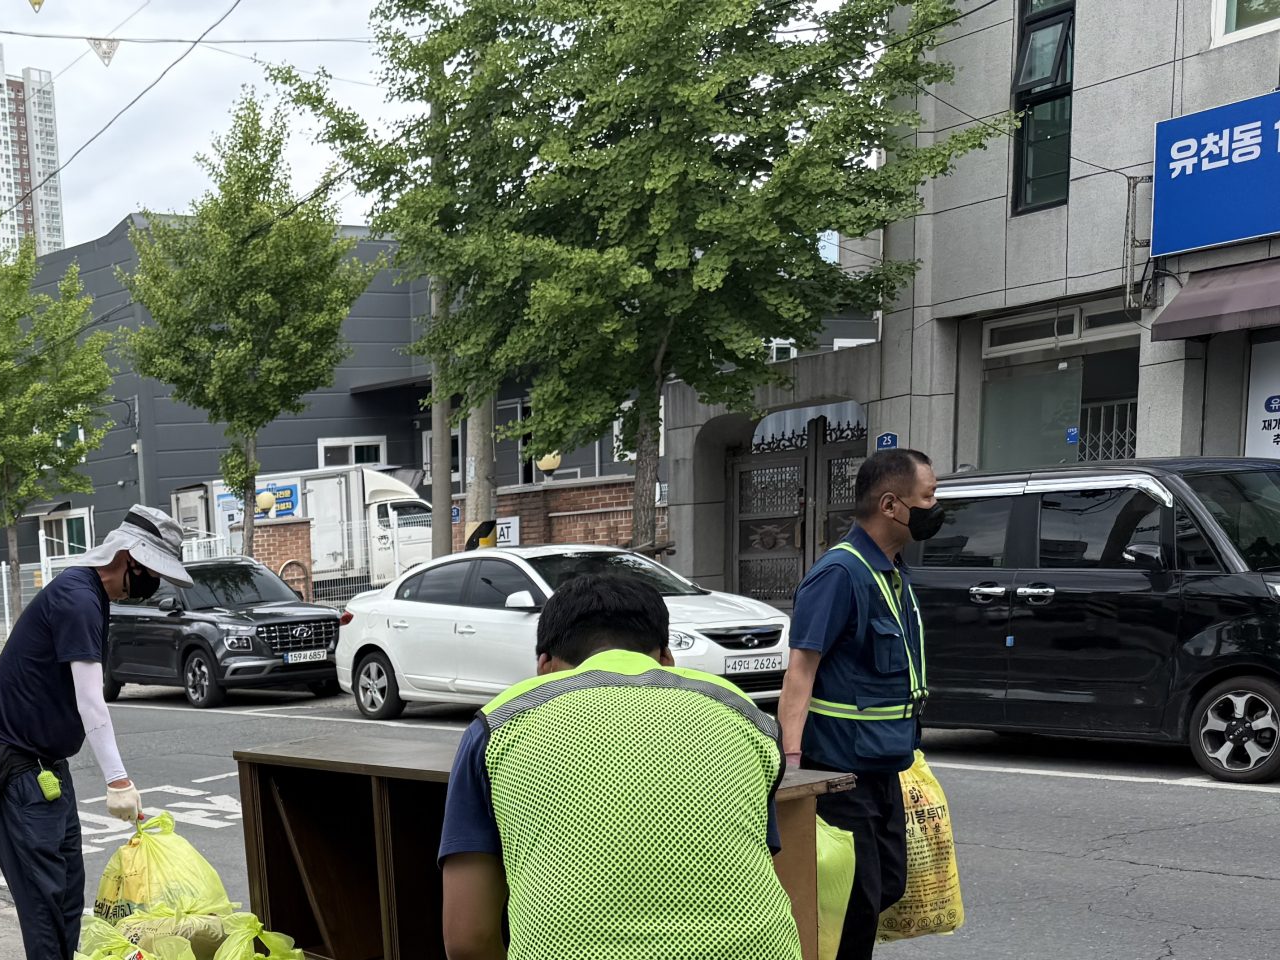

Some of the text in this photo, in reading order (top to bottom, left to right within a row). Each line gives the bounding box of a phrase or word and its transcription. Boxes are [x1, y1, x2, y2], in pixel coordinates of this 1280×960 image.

[1169, 120, 1262, 179] 유천동
[882, 435, 892, 445] 25
[498, 526, 511, 540] AT
[754, 658, 777, 670] 2626
